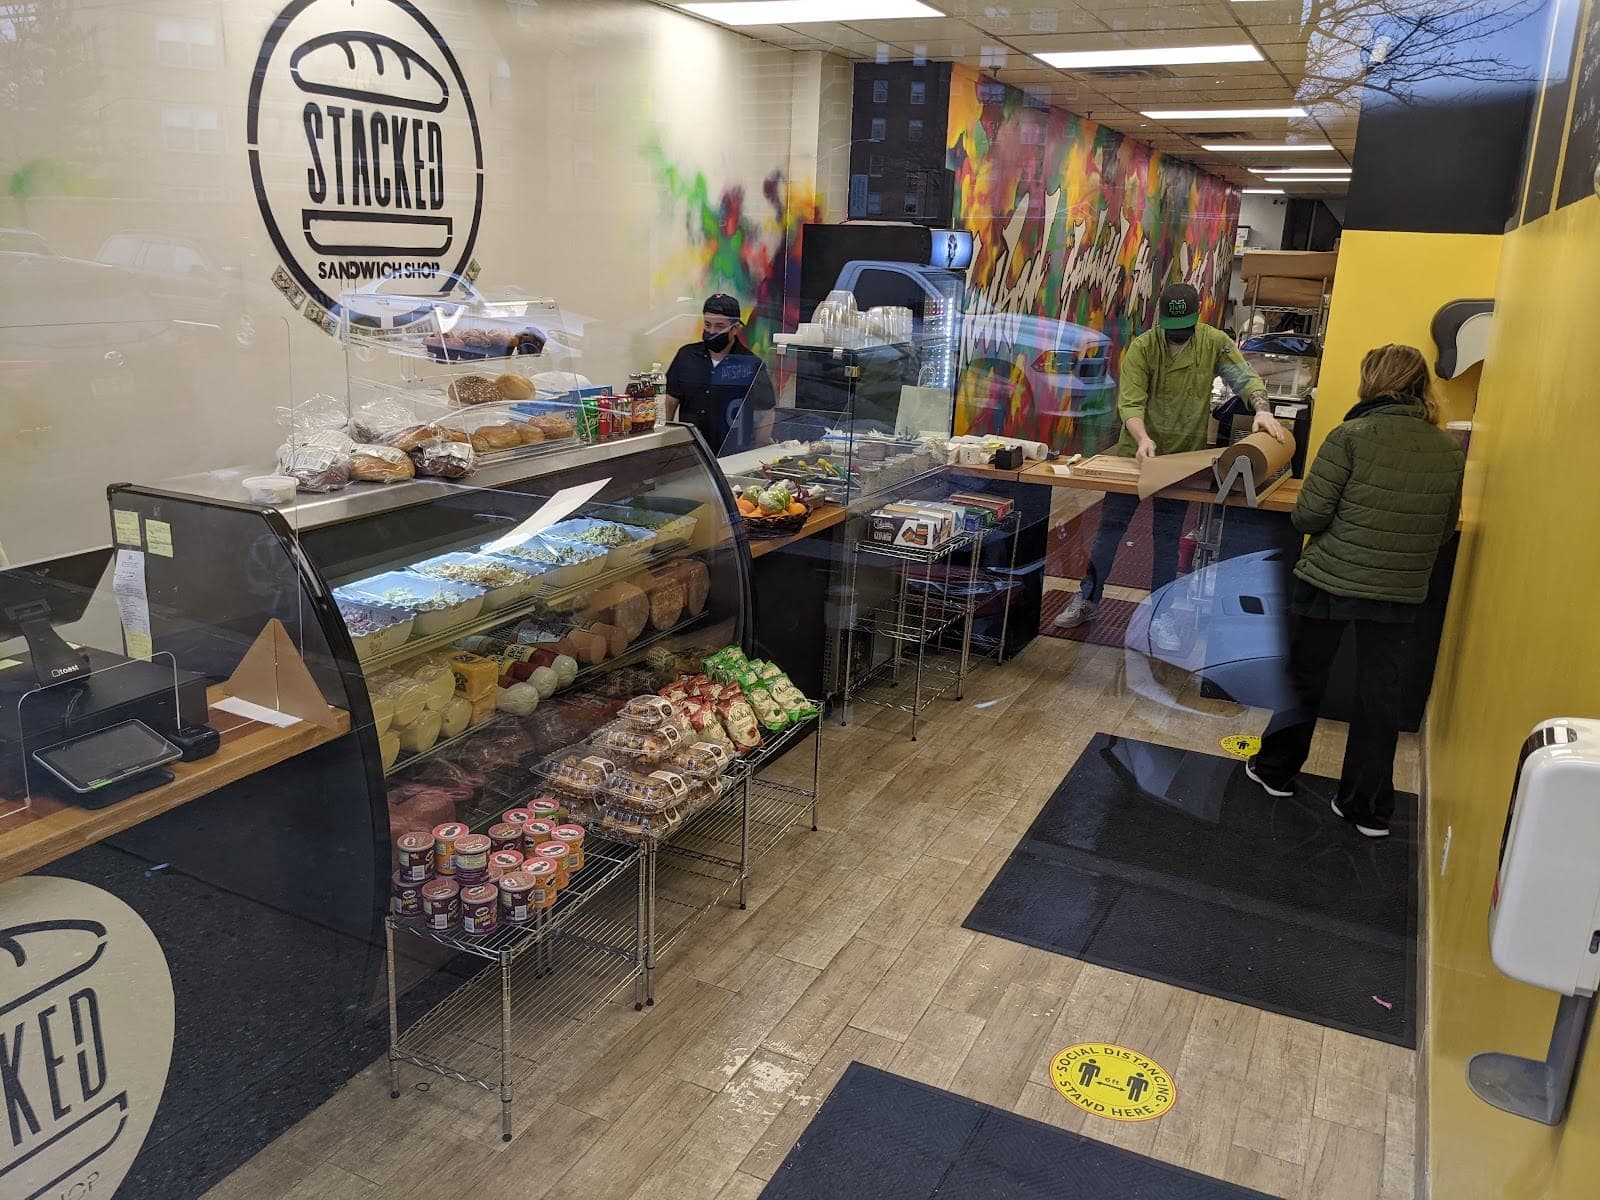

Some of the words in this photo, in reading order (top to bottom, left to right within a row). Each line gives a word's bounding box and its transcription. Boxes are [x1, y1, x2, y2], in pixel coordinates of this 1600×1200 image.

[303, 102, 444, 210] STACKED
[318, 261, 401, 280] SANDWICH
[405, 261, 440, 280] SHOP
[59, 664, 80, 675] toast
[1056, 1046, 1100, 1073] SOCIAL
[1103, 1047, 1169, 1103] DISTANCING
[1059, 1079, 1105, 1112] STAND
[1111, 1105, 1155, 1117] HERE
